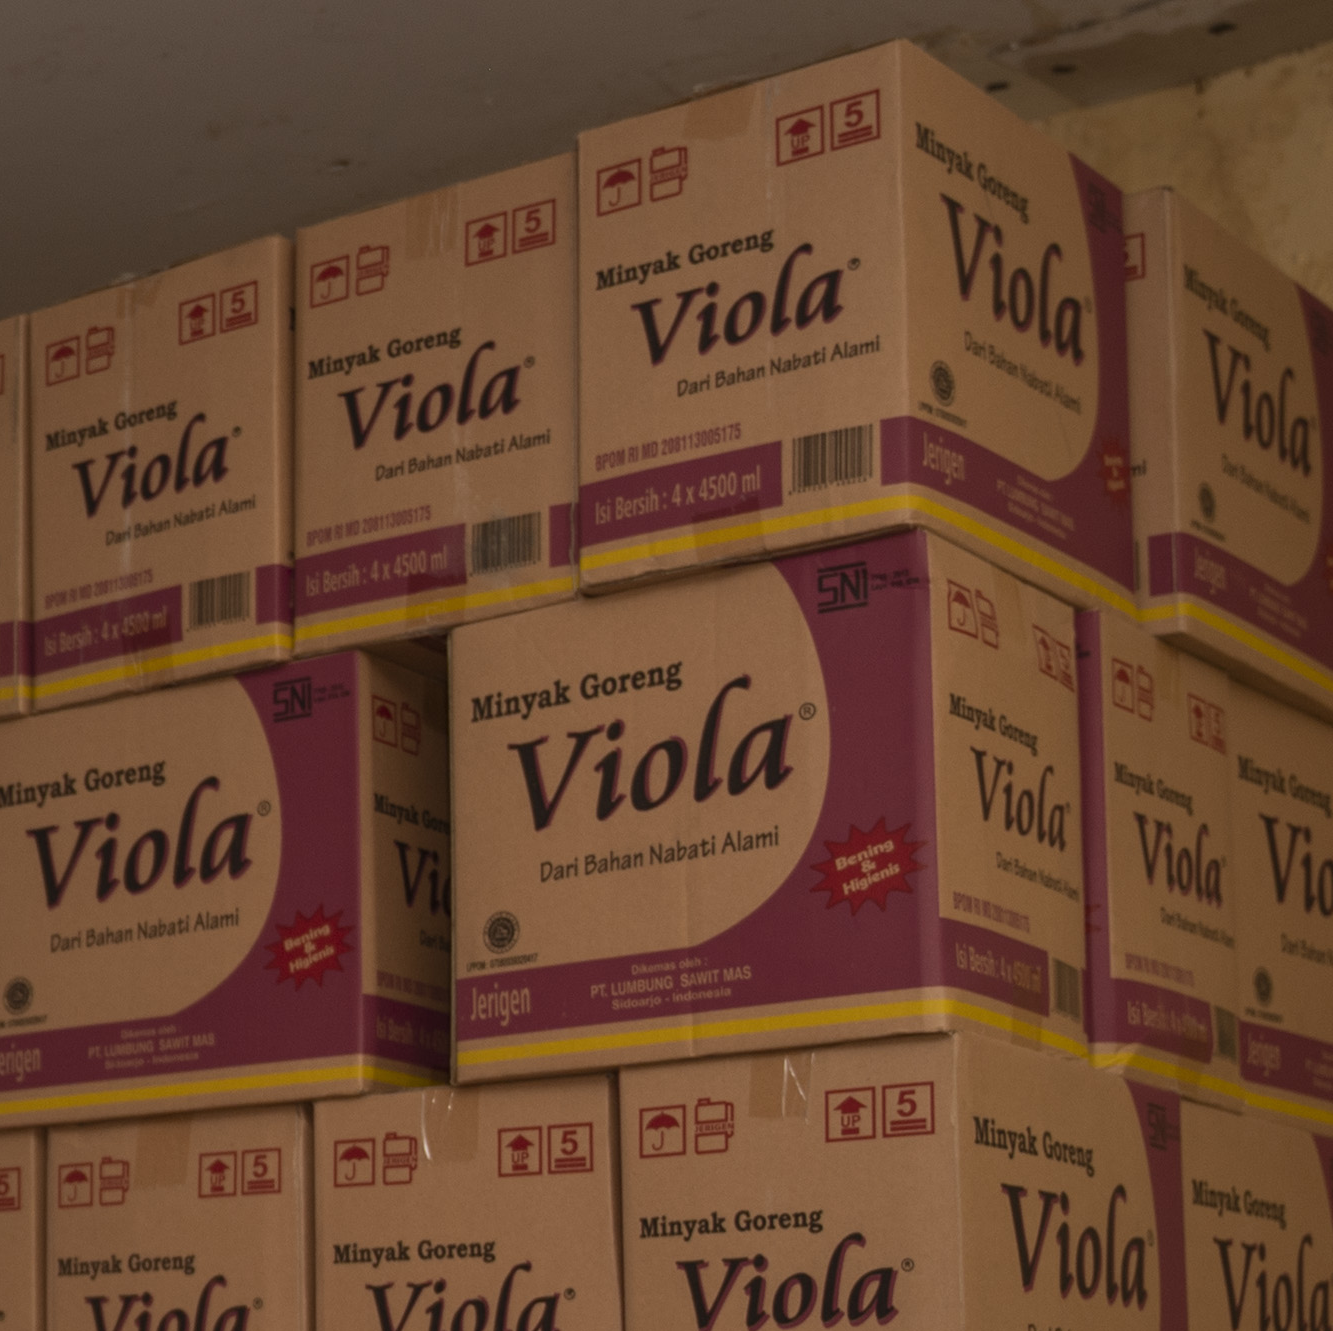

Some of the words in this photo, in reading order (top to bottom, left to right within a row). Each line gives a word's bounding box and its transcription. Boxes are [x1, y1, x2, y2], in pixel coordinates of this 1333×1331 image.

[843, 101, 866, 129] 5
[594, 252, 681, 294] Minyak
[687, 229, 776, 269] Goreng
[940, 191, 1085, 369] Viola
[630, 243, 845, 369] Viola
[338, 340, 521, 451] Viola
[675, 374, 712, 400] Dari
[714, 360, 766, 396] Bahan
[769, 344, 827, 382] Nabati
[829, 334, 882, 366] Alami
[71, 411, 230, 522] Viola
[816, 566, 869, 609] SNI
[470, 682, 572, 725] Minyak
[579, 661, 684, 706] Goreng
[83, 758, 168, 800] Goreng
[507, 673, 795, 834] Viola
[969, 743, 1069, 855] Viola
[25, 775, 255, 914] Viola
[834, 835, 897, 874] Bening
[841, 860, 903, 898] Higienis
[468, 981, 532, 1028] Jerigen
[896, 1090, 918, 1118] 5
[333, 1243, 411, 1266] Minyak
[418, 1239, 496, 1263] Goreng
[639, 1213, 727, 1241] Minyak
[734, 1208, 824, 1235] Goreng
[1001, 1182, 1149, 1312] Viola
